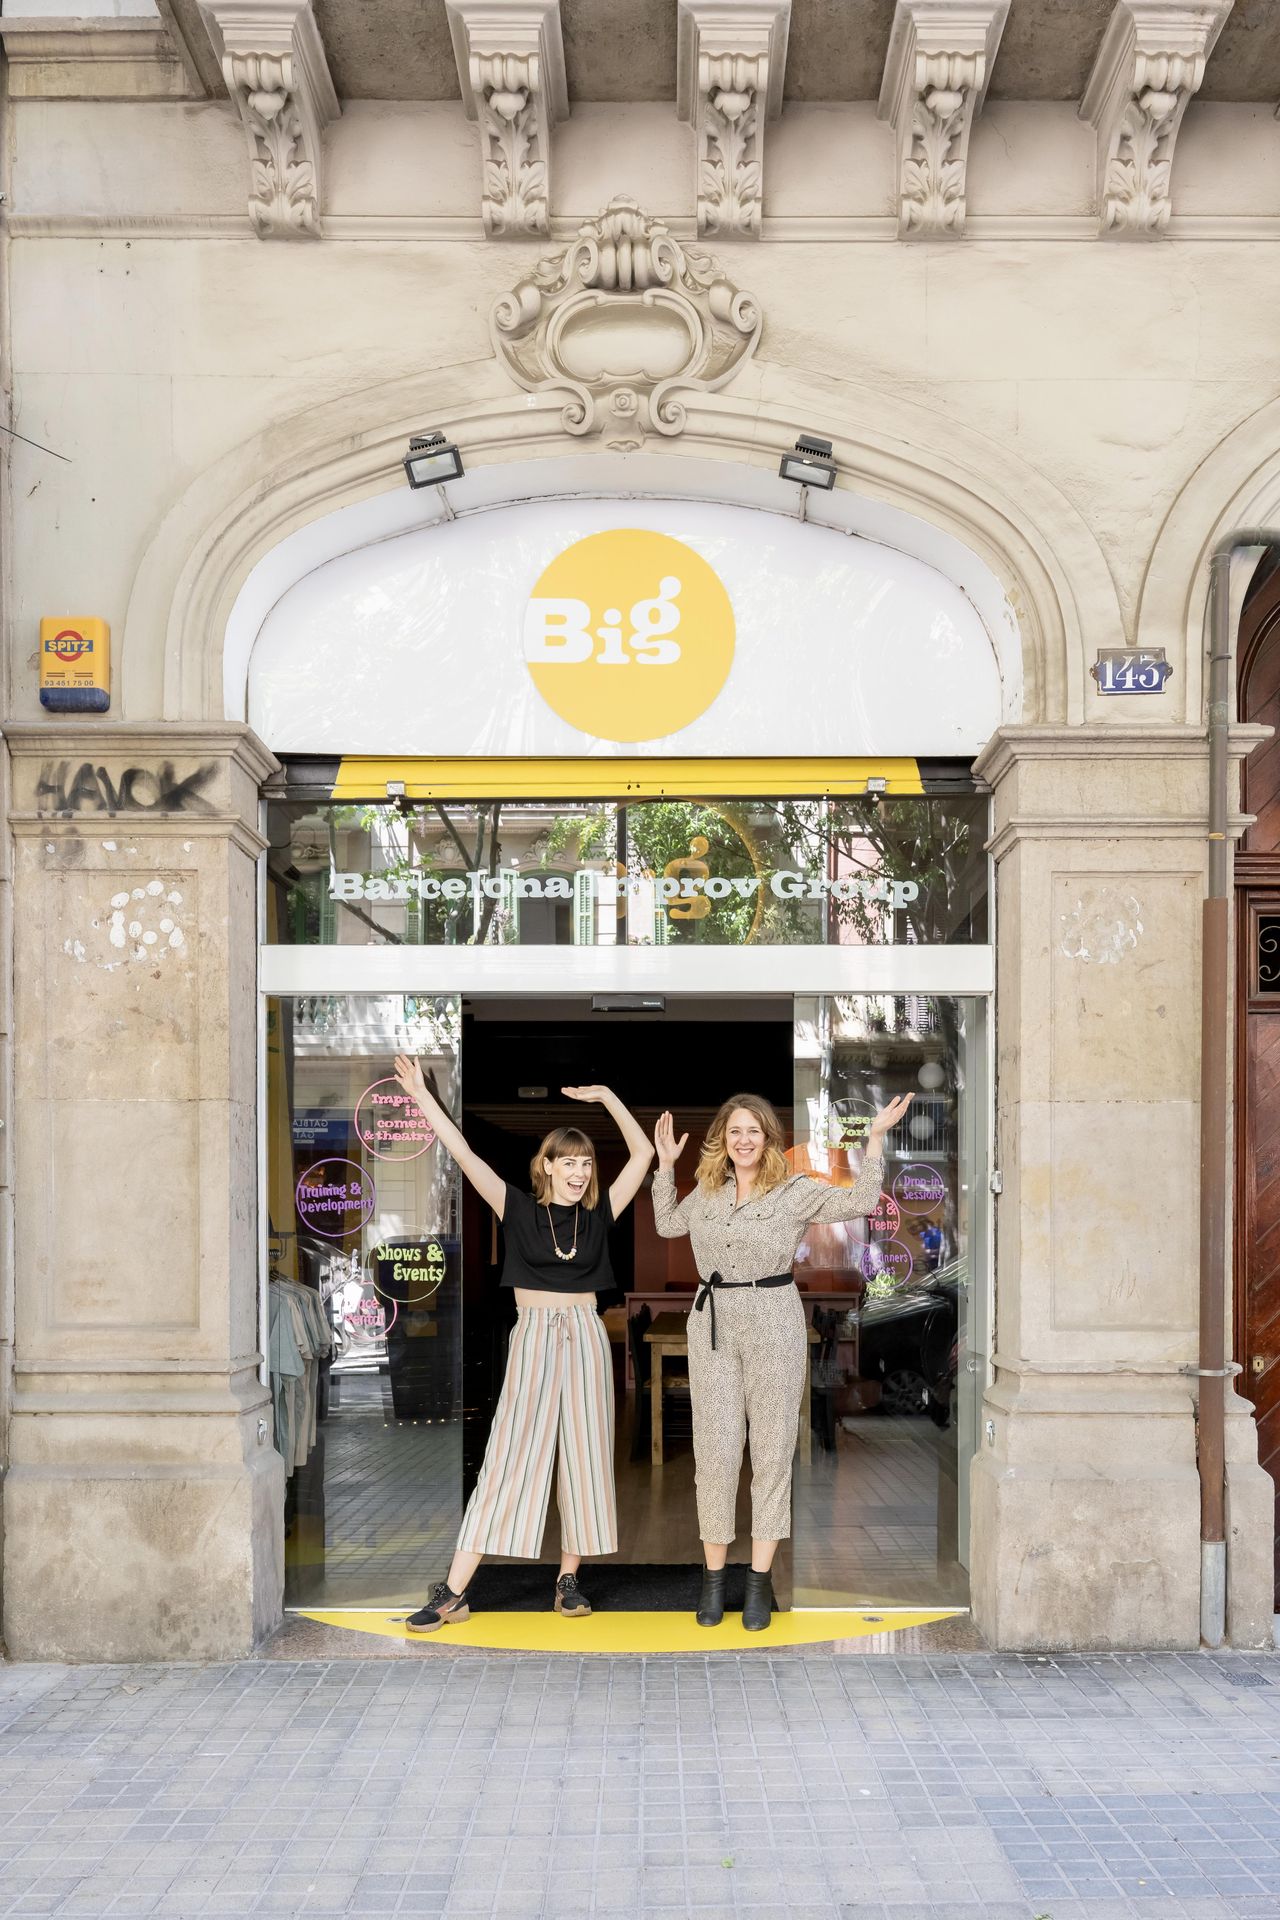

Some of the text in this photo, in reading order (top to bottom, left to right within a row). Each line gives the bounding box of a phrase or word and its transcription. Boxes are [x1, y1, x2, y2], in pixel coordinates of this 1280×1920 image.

[523, 576, 682, 665] Big
[47, 641, 90, 652] SPITZ
[1102, 654, 1160, 689] 143
[329, 871, 575, 901] Barcelona
[585, 872, 762, 906] mprov
[770, 870, 919, 909] Group
[376, 1118, 433, 1132] comedy
[363, 1129, 434, 1141] & theatre
[300, 1182, 362, 1199] Training &
[902, 1189, 944, 1200] Sessions
[299, 1198, 374, 1215] Development
[886, 1202, 897, 1215] &
[868, 1217, 898, 1231] Teens
[376, 1243, 444, 1262] Shows &
[393, 1262, 444, 1281] Events
